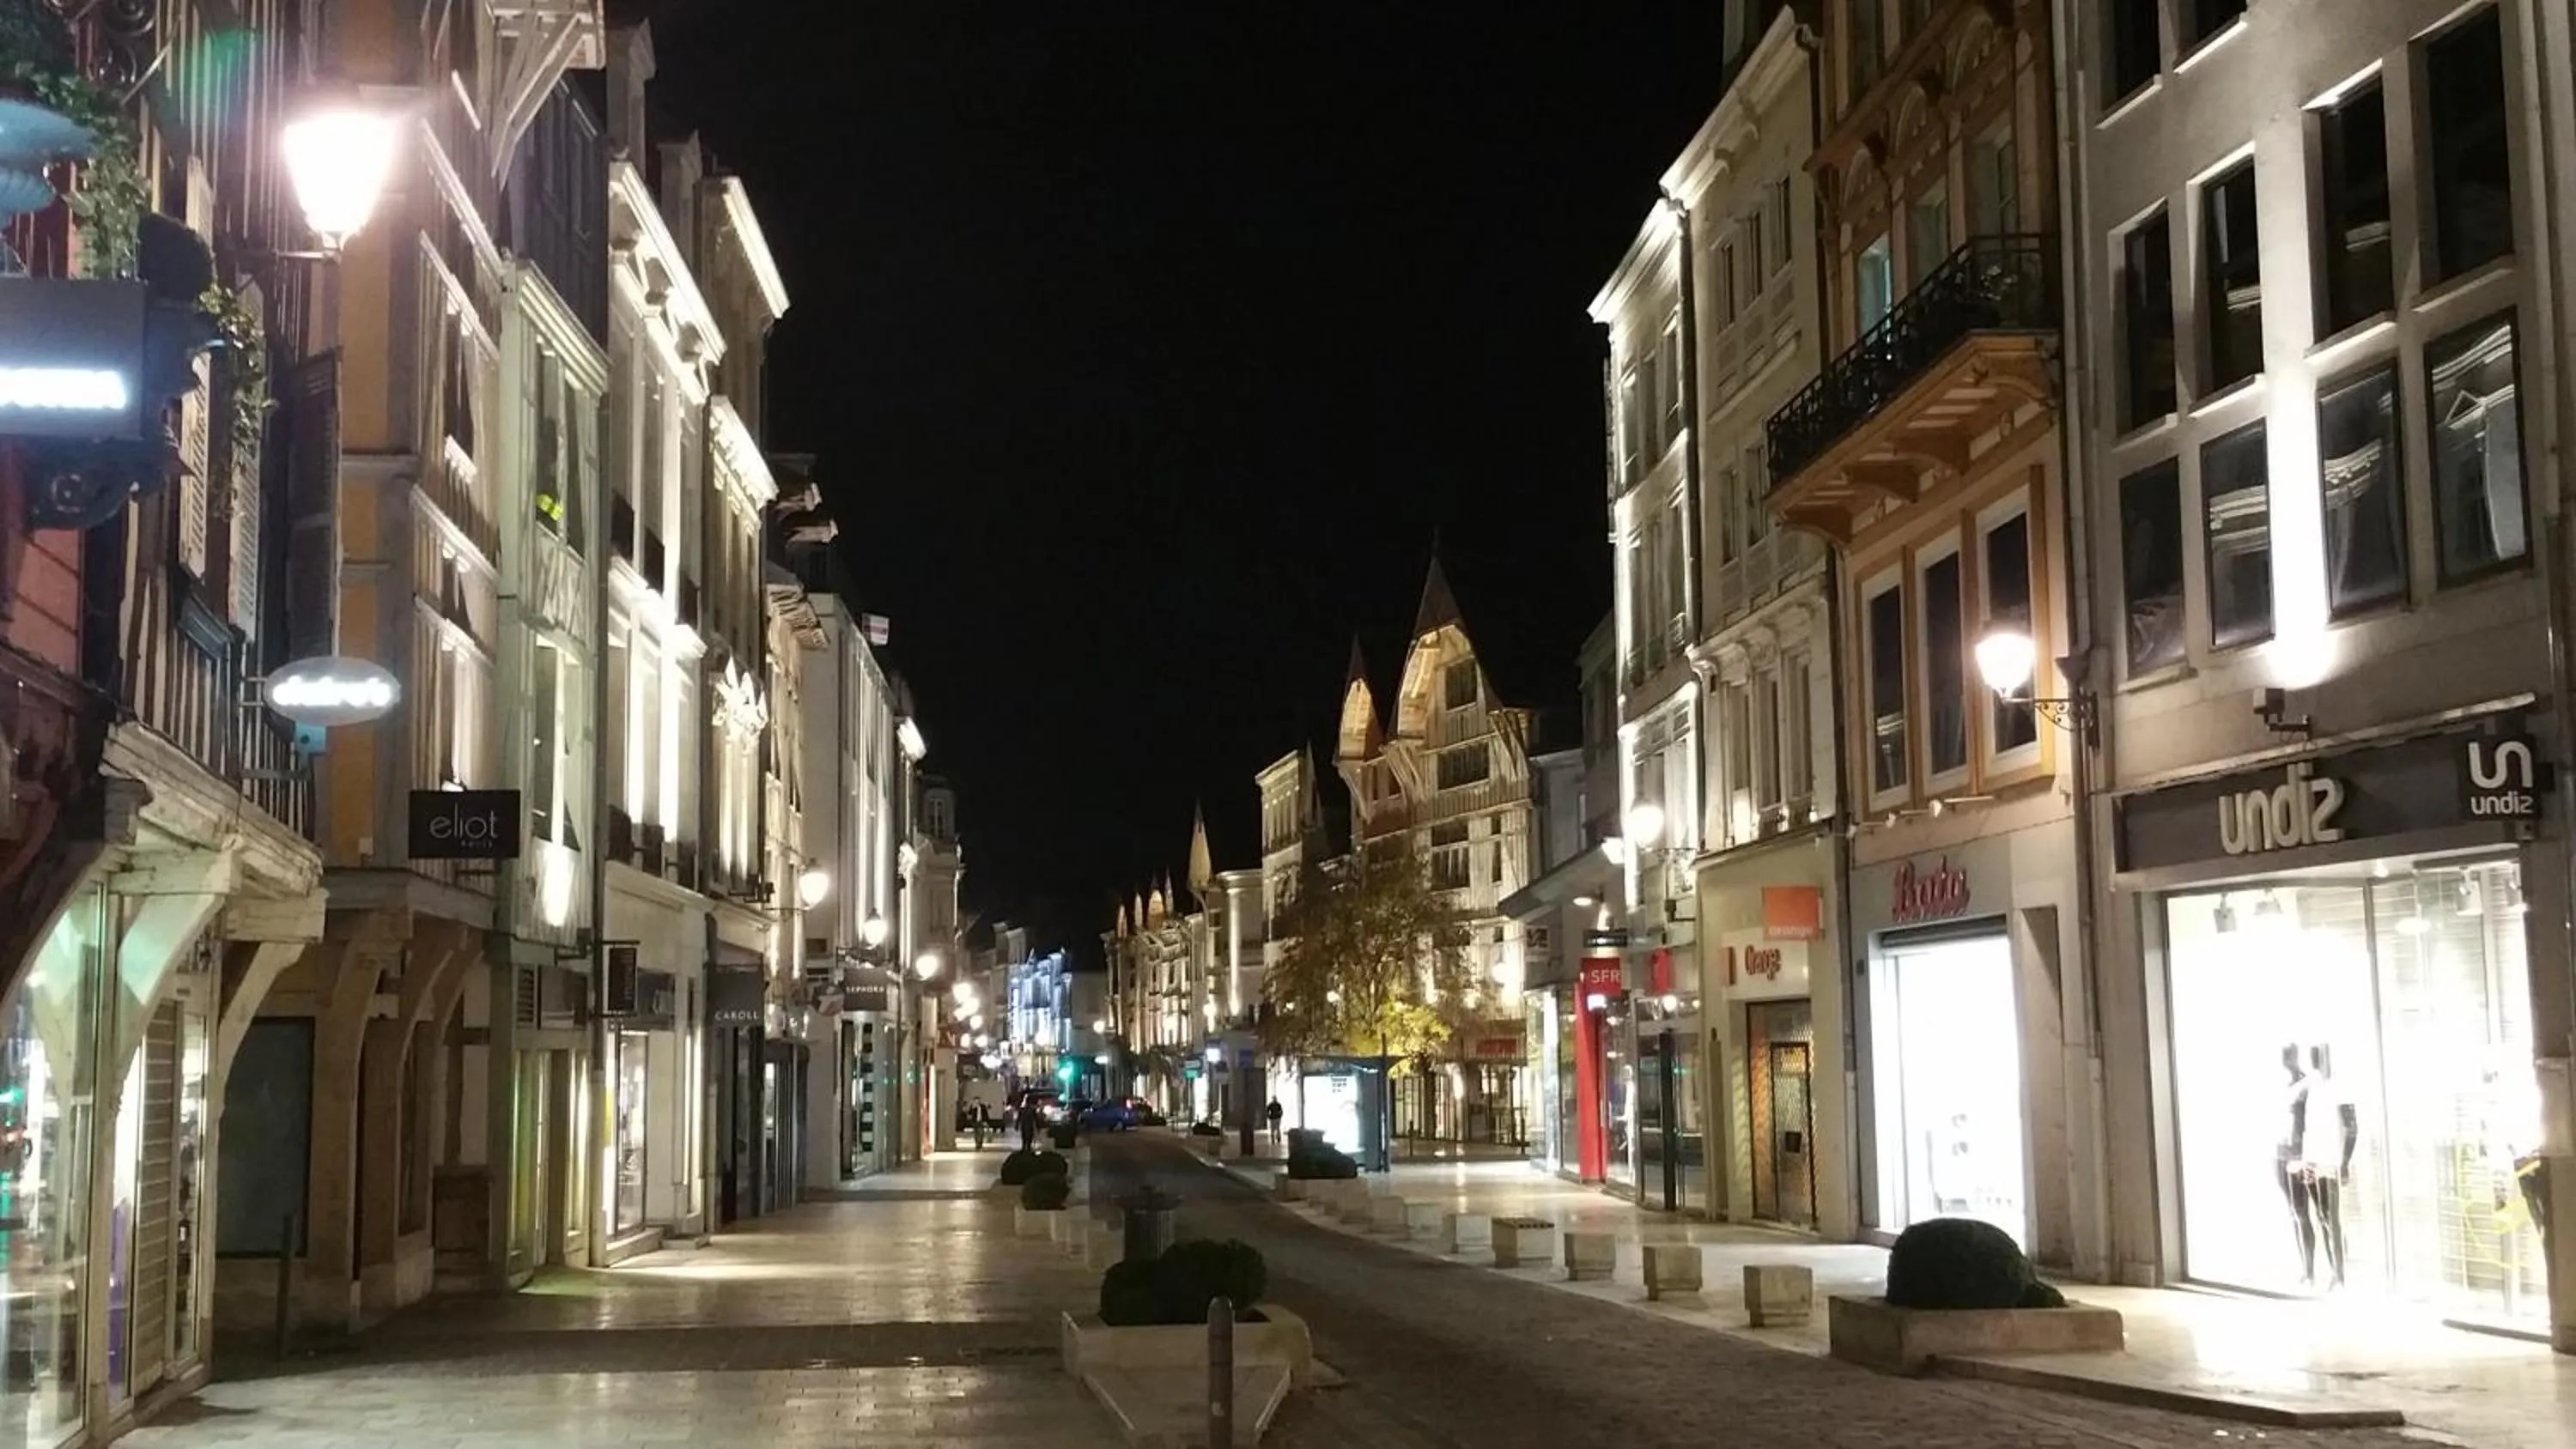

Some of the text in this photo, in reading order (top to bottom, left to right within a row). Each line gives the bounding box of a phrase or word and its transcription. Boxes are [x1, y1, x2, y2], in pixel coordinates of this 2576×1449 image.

[429, 801, 499, 840] eliot
[1590, 968, 1621, 984] SFR
[714, 1009, 761, 1022] CAROLL
